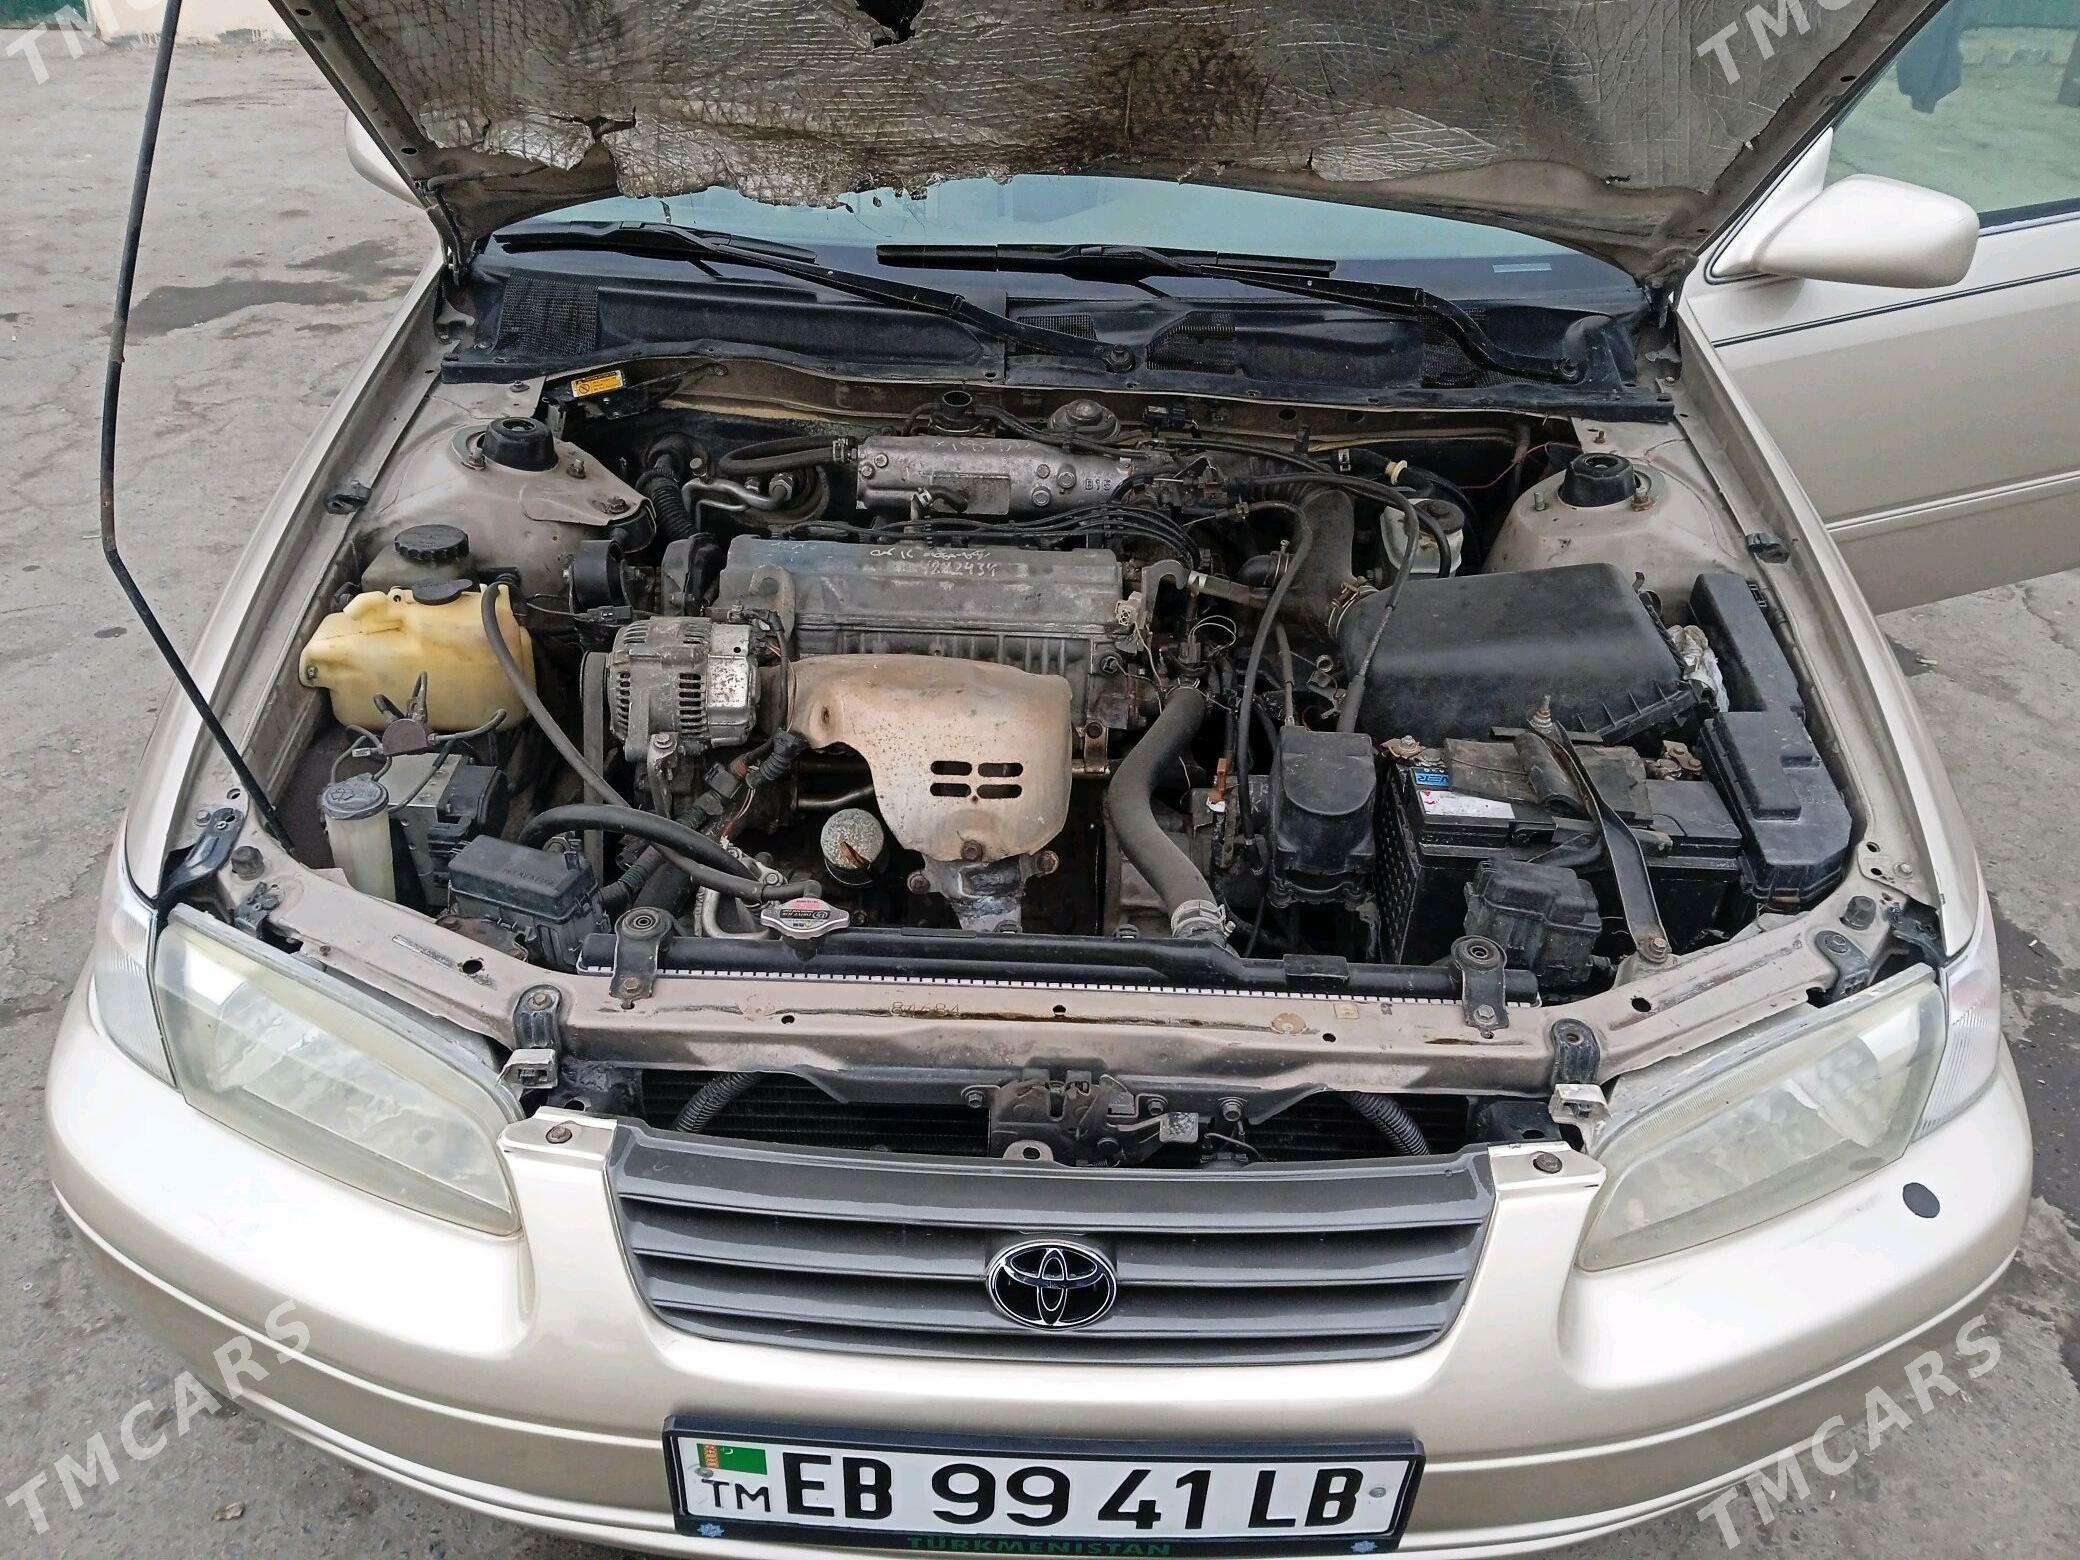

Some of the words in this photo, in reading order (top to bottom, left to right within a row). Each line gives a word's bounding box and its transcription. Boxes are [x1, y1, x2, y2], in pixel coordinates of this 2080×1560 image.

[701, 1478, 771, 1513] TM
[783, 1452, 892, 1520] EB
[931, 1463, 1070, 1528] 99
[1098, 1469, 1211, 1530] 41
[1248, 1468, 1363, 1529] LB
